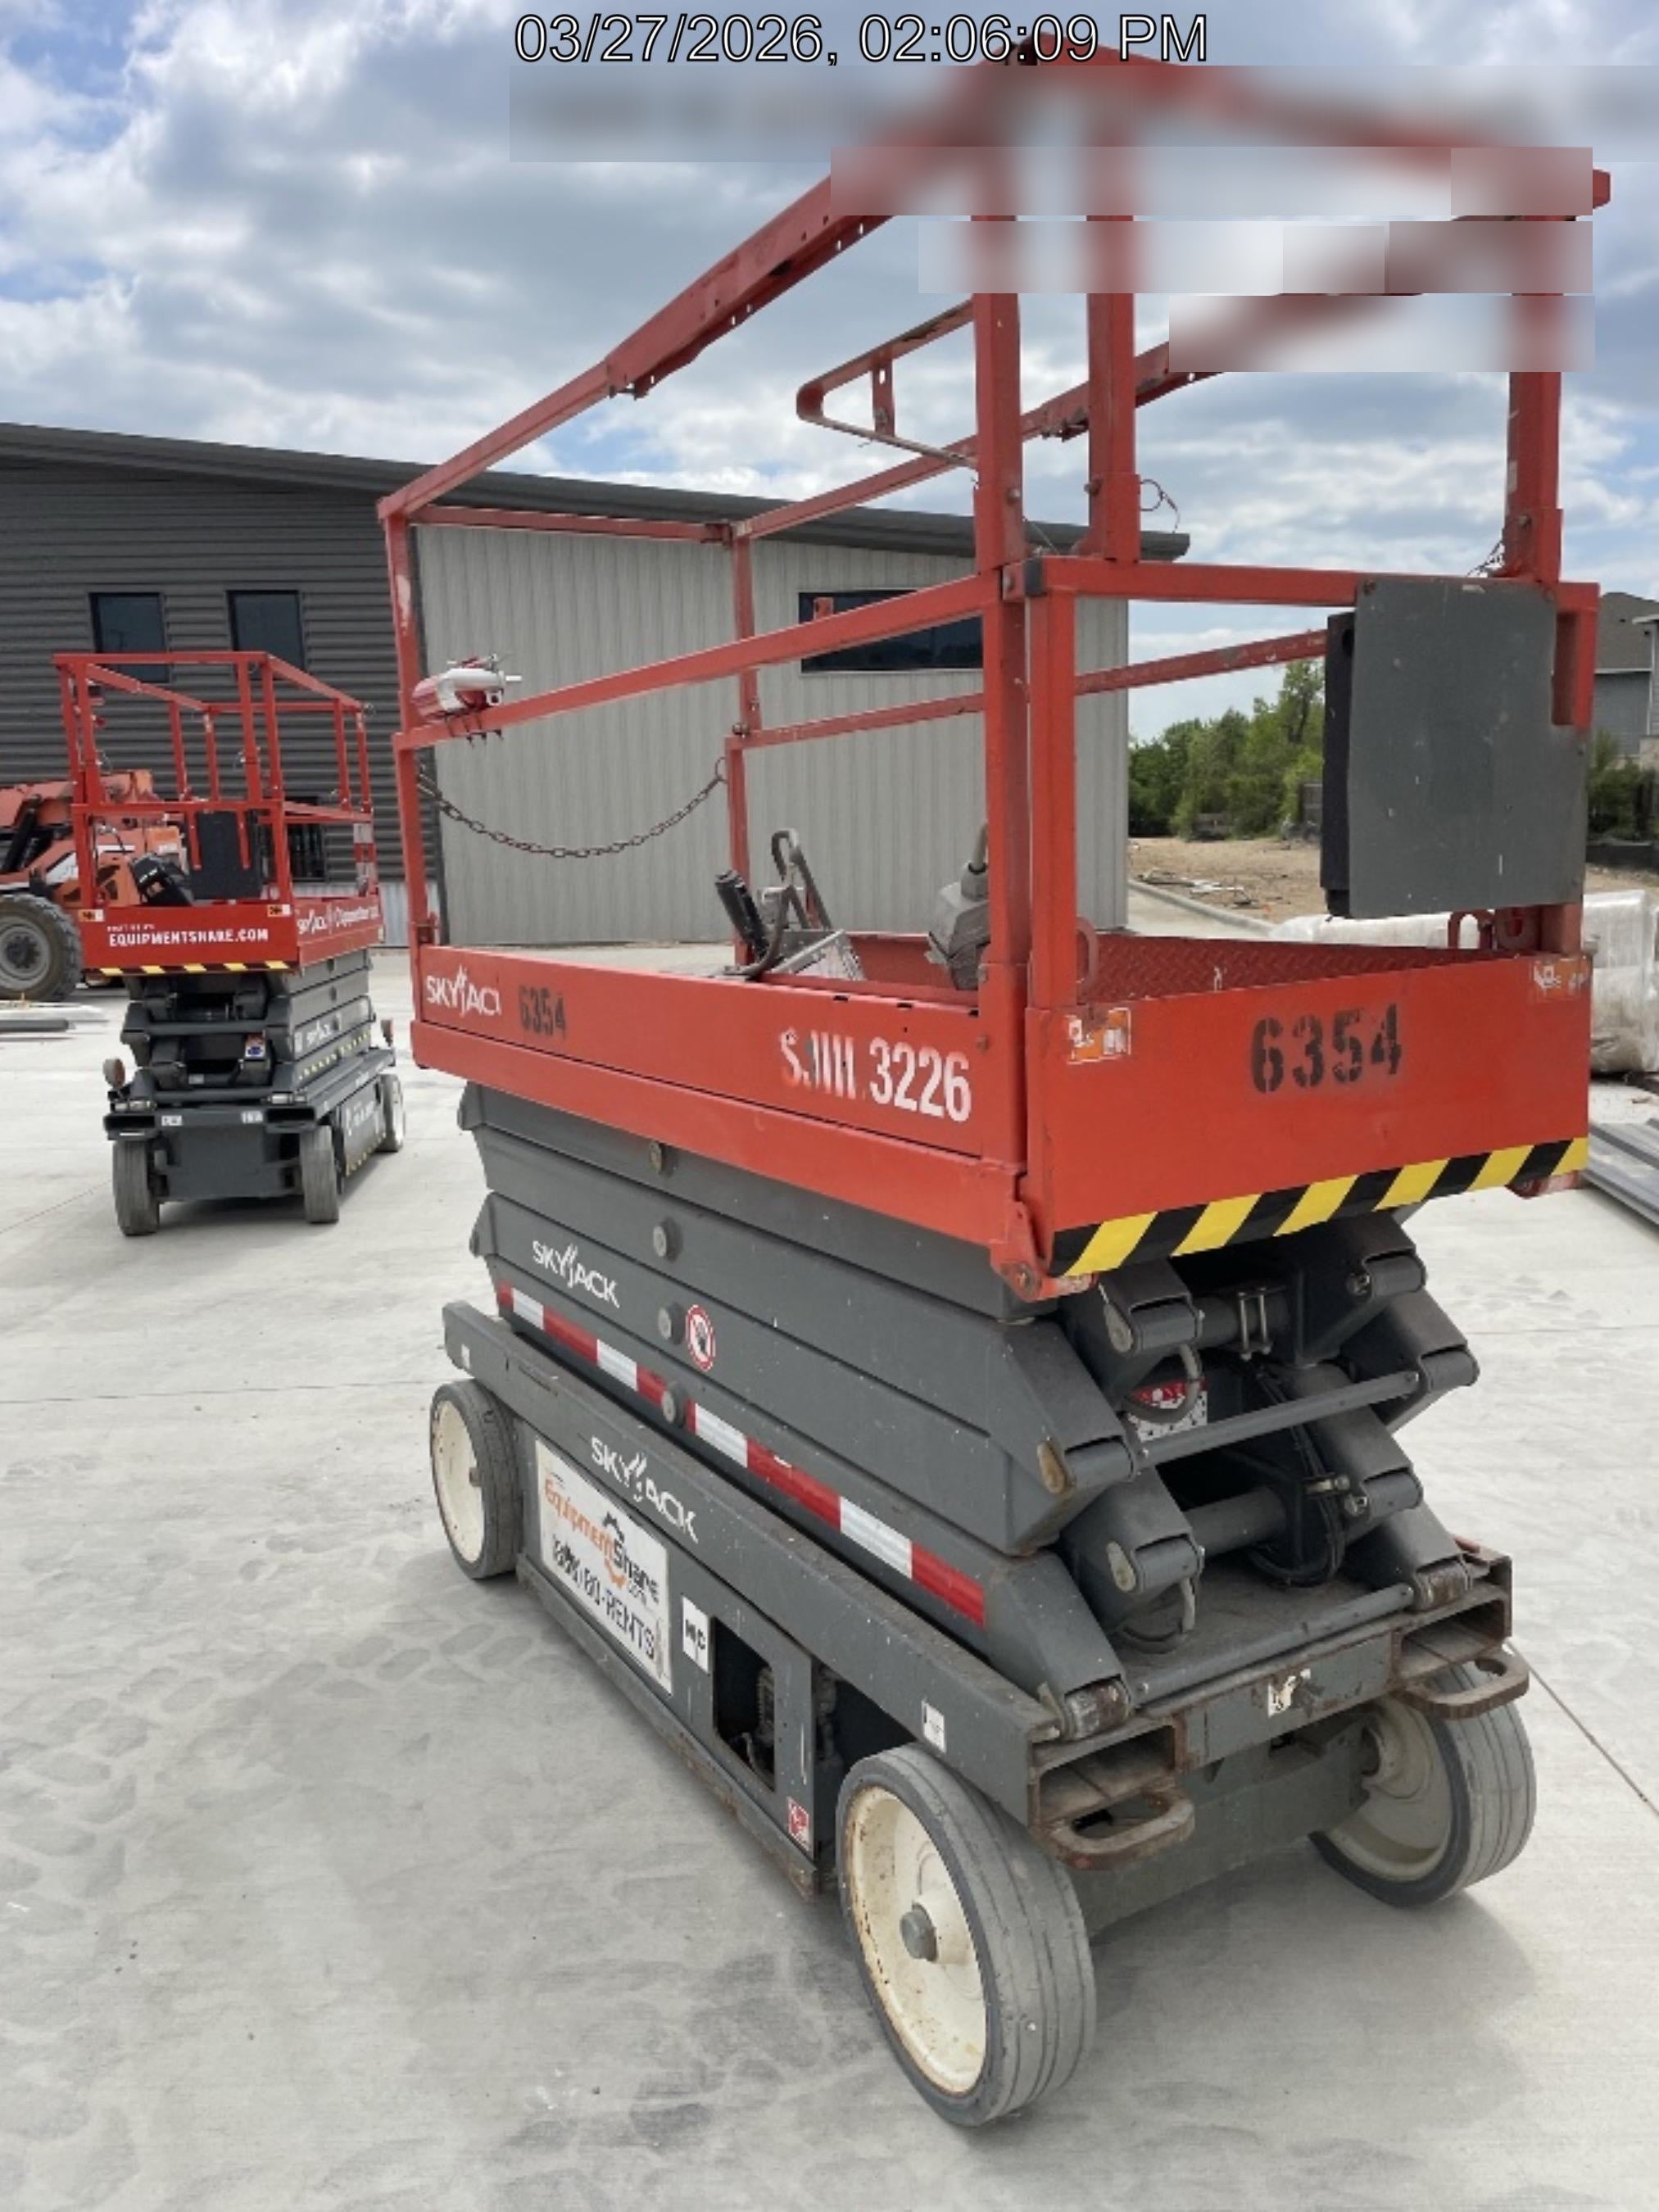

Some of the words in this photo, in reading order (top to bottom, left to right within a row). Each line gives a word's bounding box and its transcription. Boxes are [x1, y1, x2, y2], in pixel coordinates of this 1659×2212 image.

[109, 928, 269, 947] EQUIPMENTSHARE.COM
[519, 986, 567, 1038] 6354
[1251, 1003, 1403, 1094] 6354
[869, 1036, 972, 1122] 3226
[532, 1240, 620, 1308] SKYJACK
[591, 1436, 699, 1542] SKYJACK
